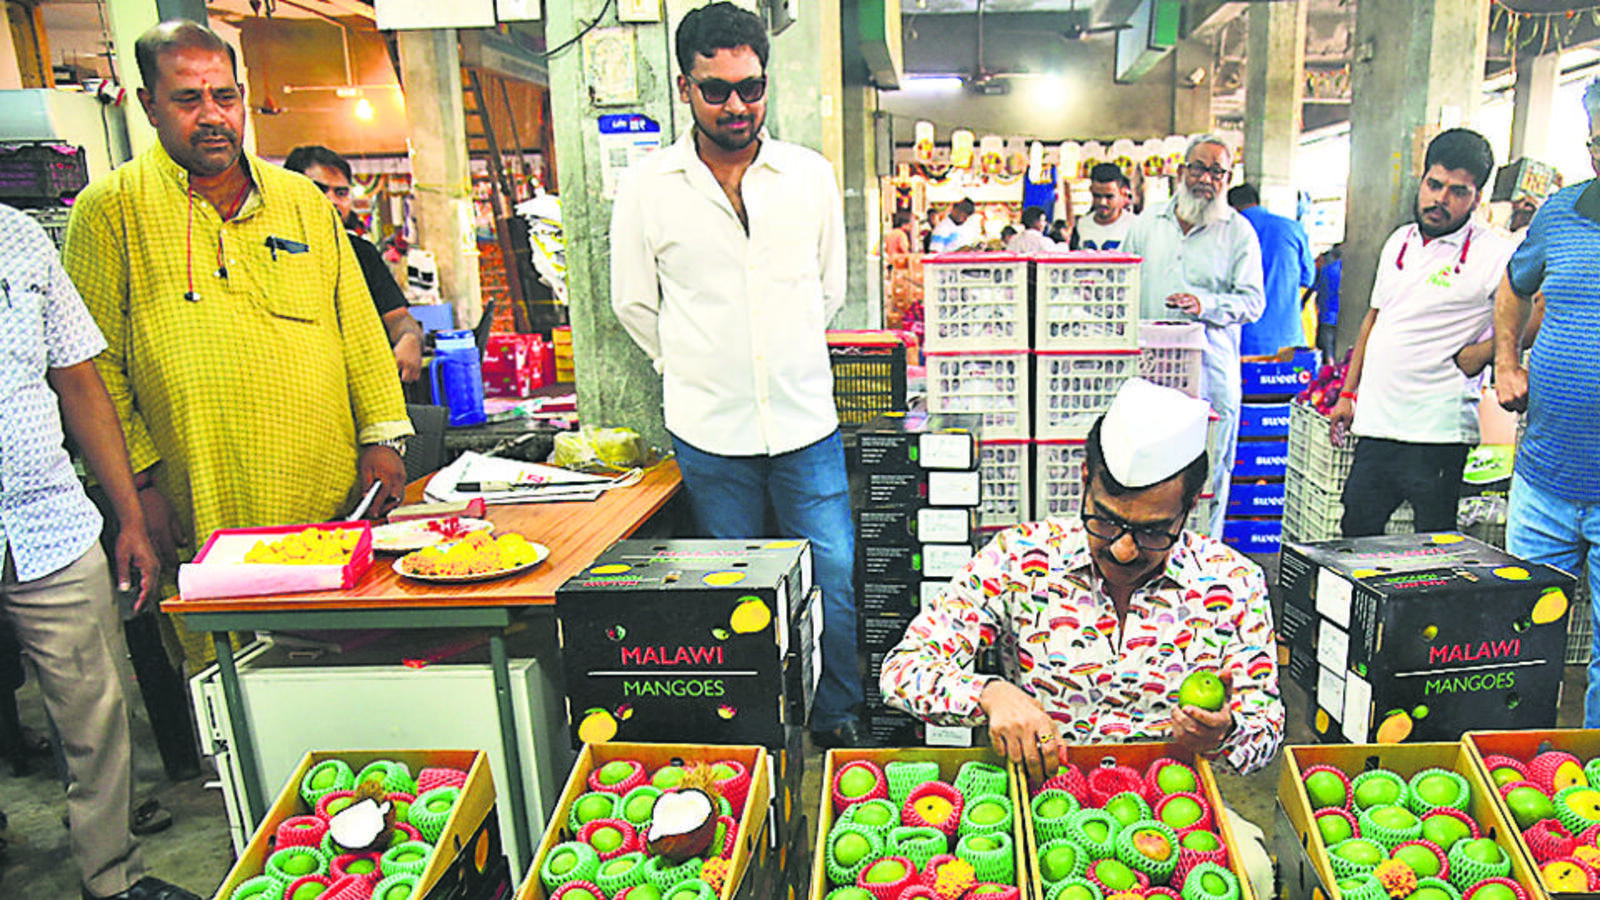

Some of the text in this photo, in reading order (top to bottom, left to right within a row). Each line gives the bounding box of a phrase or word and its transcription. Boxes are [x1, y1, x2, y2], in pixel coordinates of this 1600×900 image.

[1261, 416, 1291, 426] swee
[1255, 455, 1288, 466] swee
[1252, 496, 1286, 507] swee
[1251, 533, 1282, 543] swee
[621, 646, 724, 665] MALAWI
[1429, 638, 1521, 664] MALAWI
[623, 679, 725, 697] MANGOES
[1424, 671, 1516, 696] MANGOES
